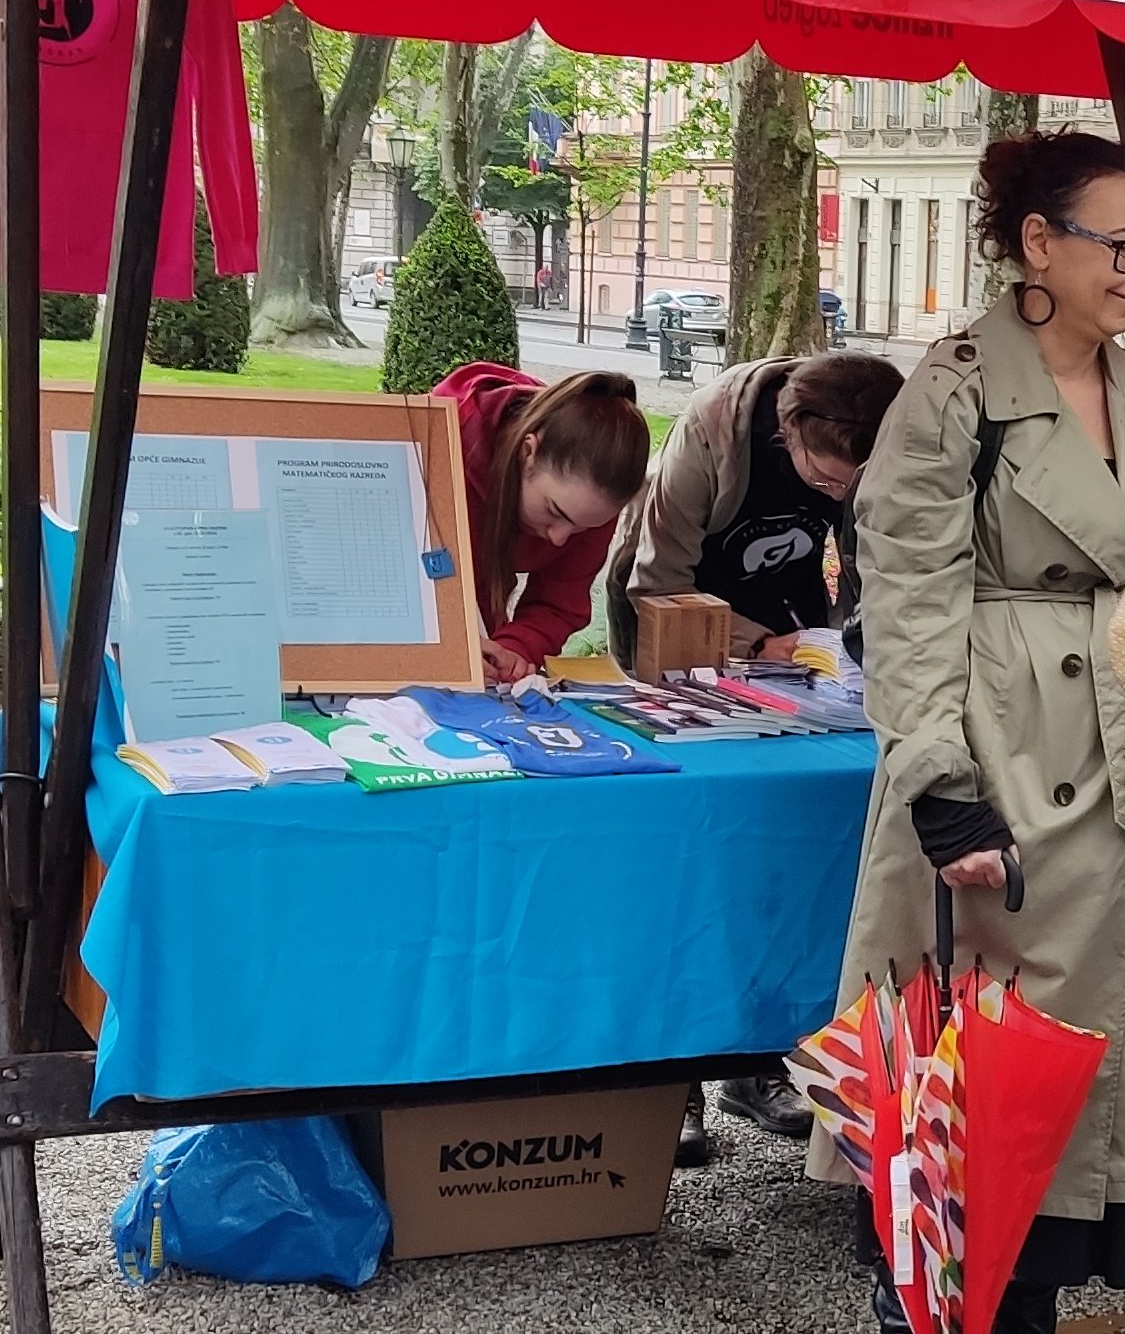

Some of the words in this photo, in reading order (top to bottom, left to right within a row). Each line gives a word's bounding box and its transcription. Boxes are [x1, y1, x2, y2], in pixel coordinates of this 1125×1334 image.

[277, 459, 319, 468] PROGRAM
[320, 460, 390, 470] PRIRODOSLOVNO
[282, 470, 348, 479] MATEMATIČKOG
[349, 471, 388, 480] RAZREDA
[374, 771, 433, 785] PRVA
[440, 1132, 603, 1172] KONZUM
[438, 1168, 603, 1198] www.konzum.hr
